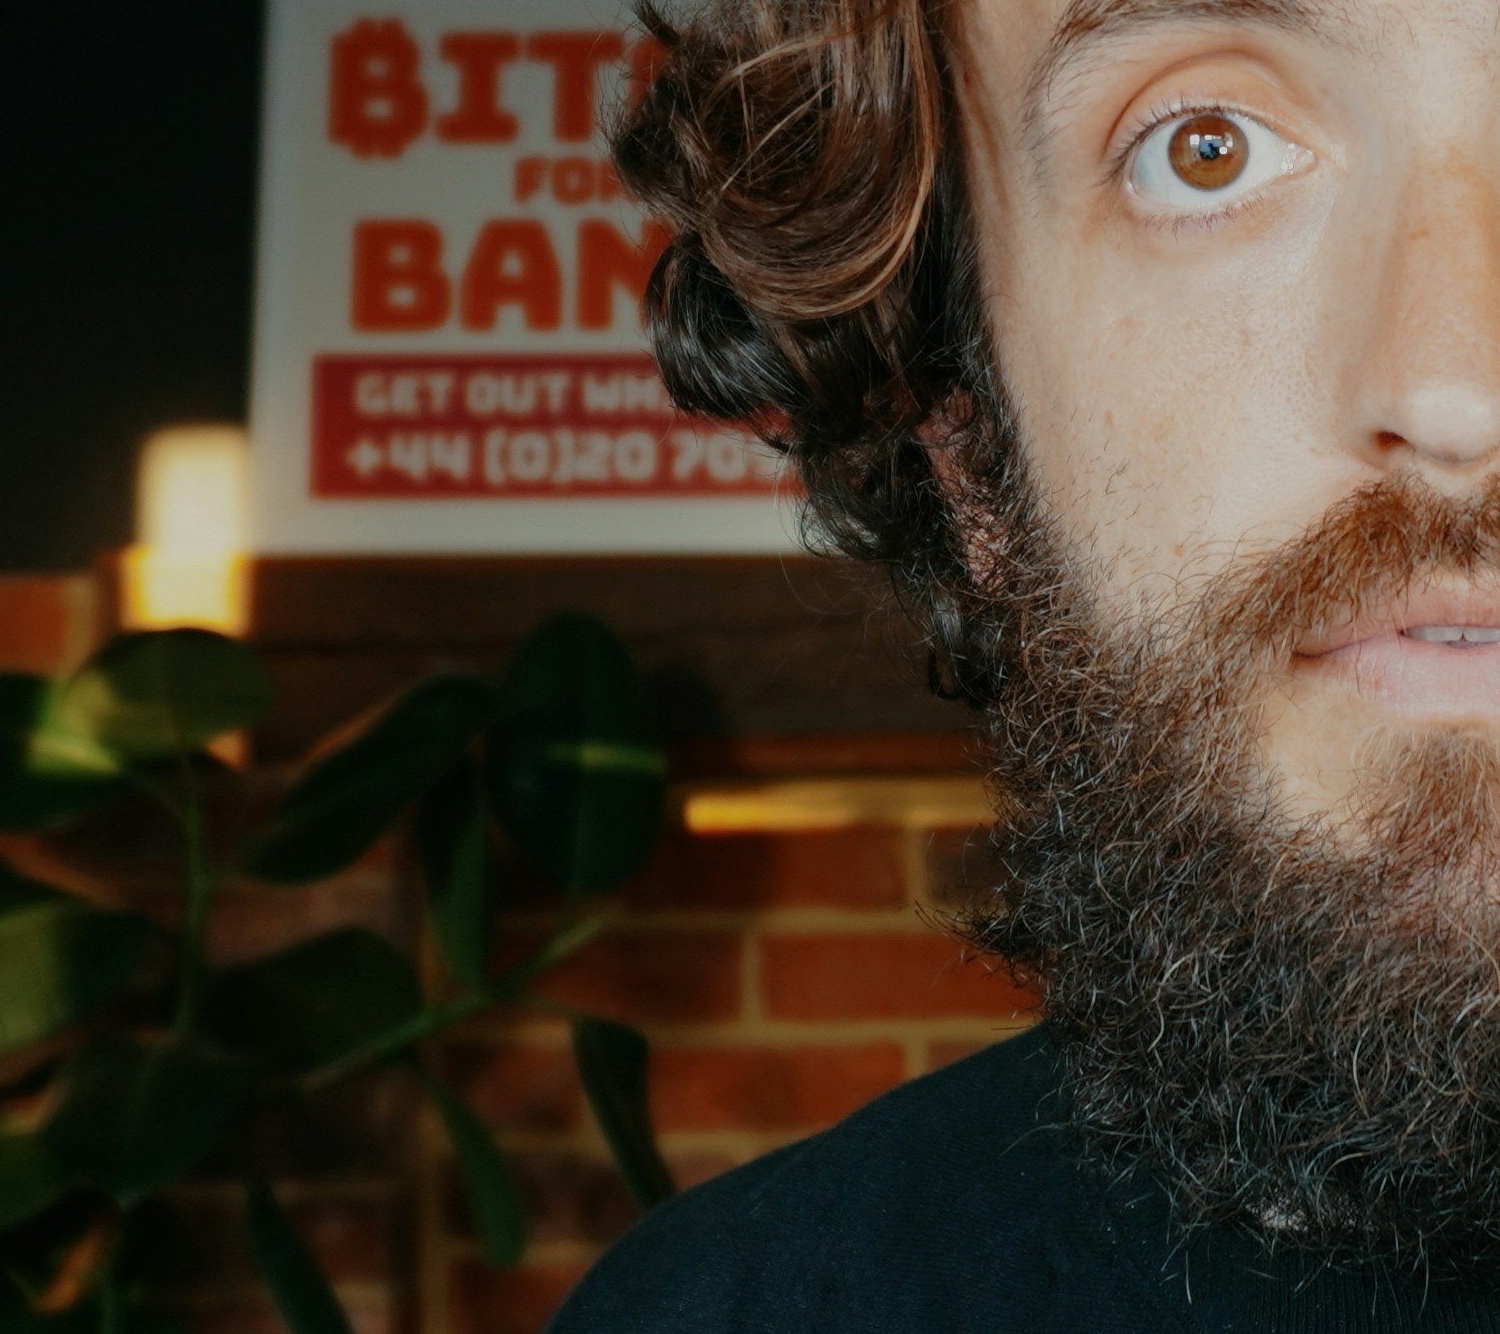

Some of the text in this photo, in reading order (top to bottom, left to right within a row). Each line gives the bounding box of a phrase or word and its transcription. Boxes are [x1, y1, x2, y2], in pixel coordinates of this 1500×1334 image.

[355, 376, 455, 415] GET
[467, 374, 569, 414] OUT
[347, 433, 471, 483] +44
